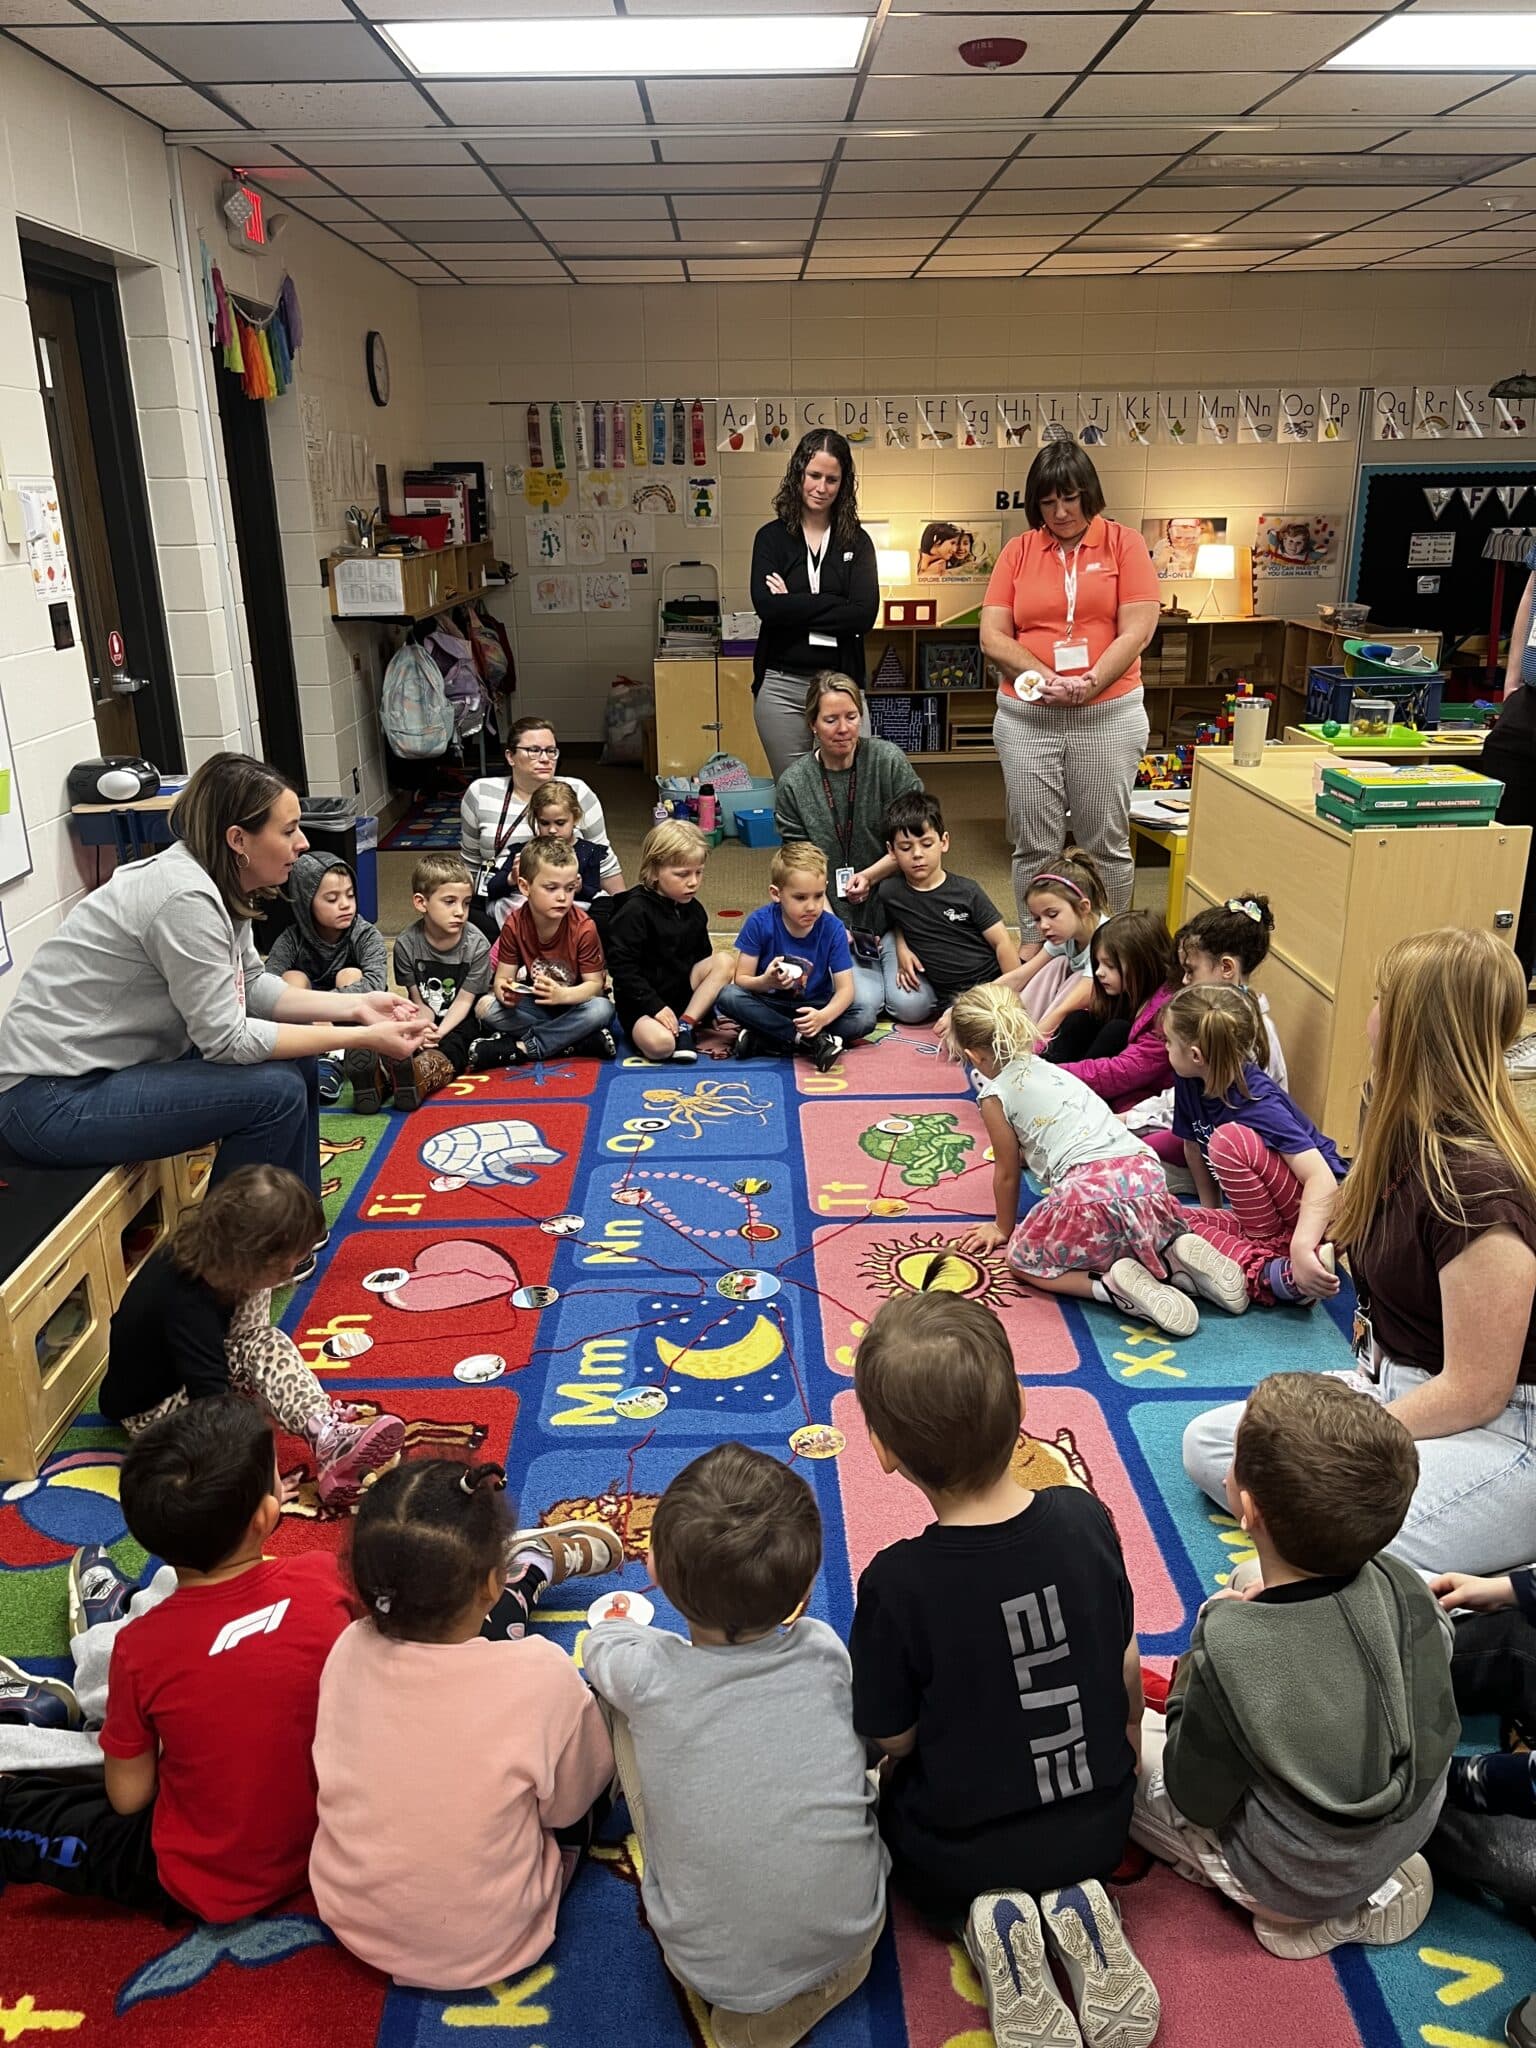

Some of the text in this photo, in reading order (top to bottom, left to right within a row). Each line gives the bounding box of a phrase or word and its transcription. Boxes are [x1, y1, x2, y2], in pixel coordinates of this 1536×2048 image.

[722, 393, 1350, 434] Aa Bb Cc Dd Ee Ff Gg Hh Ii Jj Kk Ll Mm Nn Oo Pp
[1377, 391, 1410, 426] Qq
[1425, 391, 1448, 413] Rr
[1464, 390, 1484, 412] Ss
[636, 423, 645, 451] yellow
[367, 1192, 428, 1218] Ii
[818, 1182, 869, 1211] Tt
[582, 1218, 645, 1264] Nn
[1112, 1325, 1188, 1379] Xx
[549, 1338, 628, 1426] Mm
[1000, 1583, 1094, 1804] ELITE
